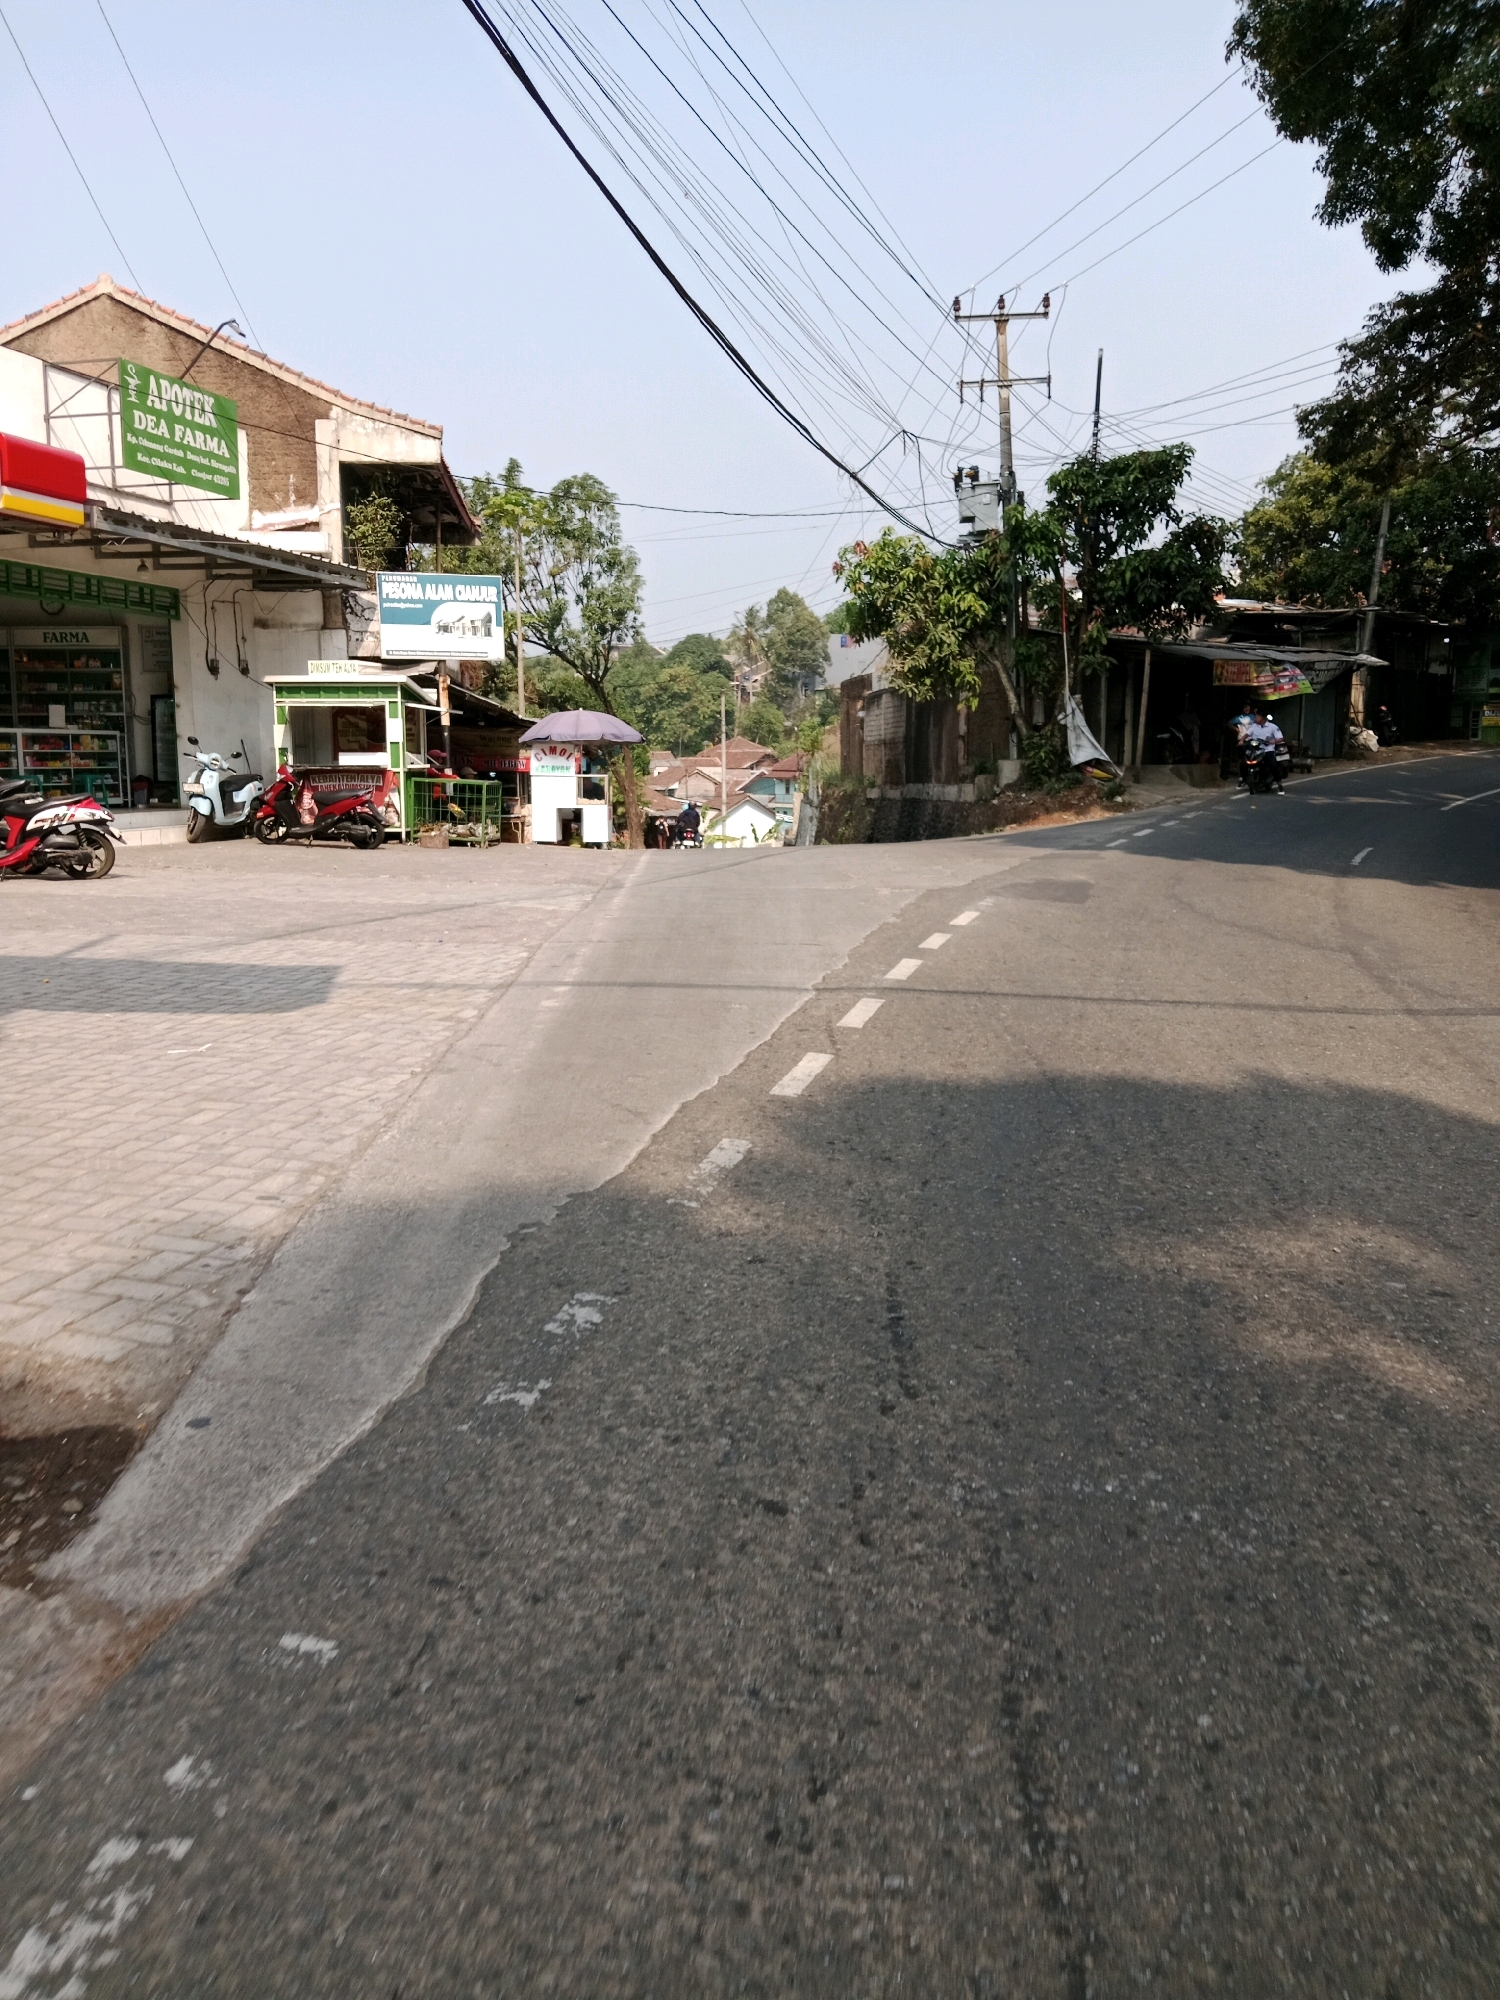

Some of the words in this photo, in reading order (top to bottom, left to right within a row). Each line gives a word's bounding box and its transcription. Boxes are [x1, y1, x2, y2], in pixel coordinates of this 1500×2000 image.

[147, 375, 217, 428] APOTEK
[133, 410, 170, 438] DEA
[174, 424, 230, 458] FARMA
[381, 582, 425, 600] PESONA
[425, 583, 455, 601] ALAM
[455, 584, 499, 603] CIANJUR
[43, 631, 90, 644] FARMA
[310, 662, 331, 674] DIMSUM
[332, 663, 343, 673] TEH
[344, 662, 357, 673] ALYA
[534, 745, 574, 762] CIMOL
[340, 774, 357, 784] TEH
[359, 774, 382, 785] ALYA
